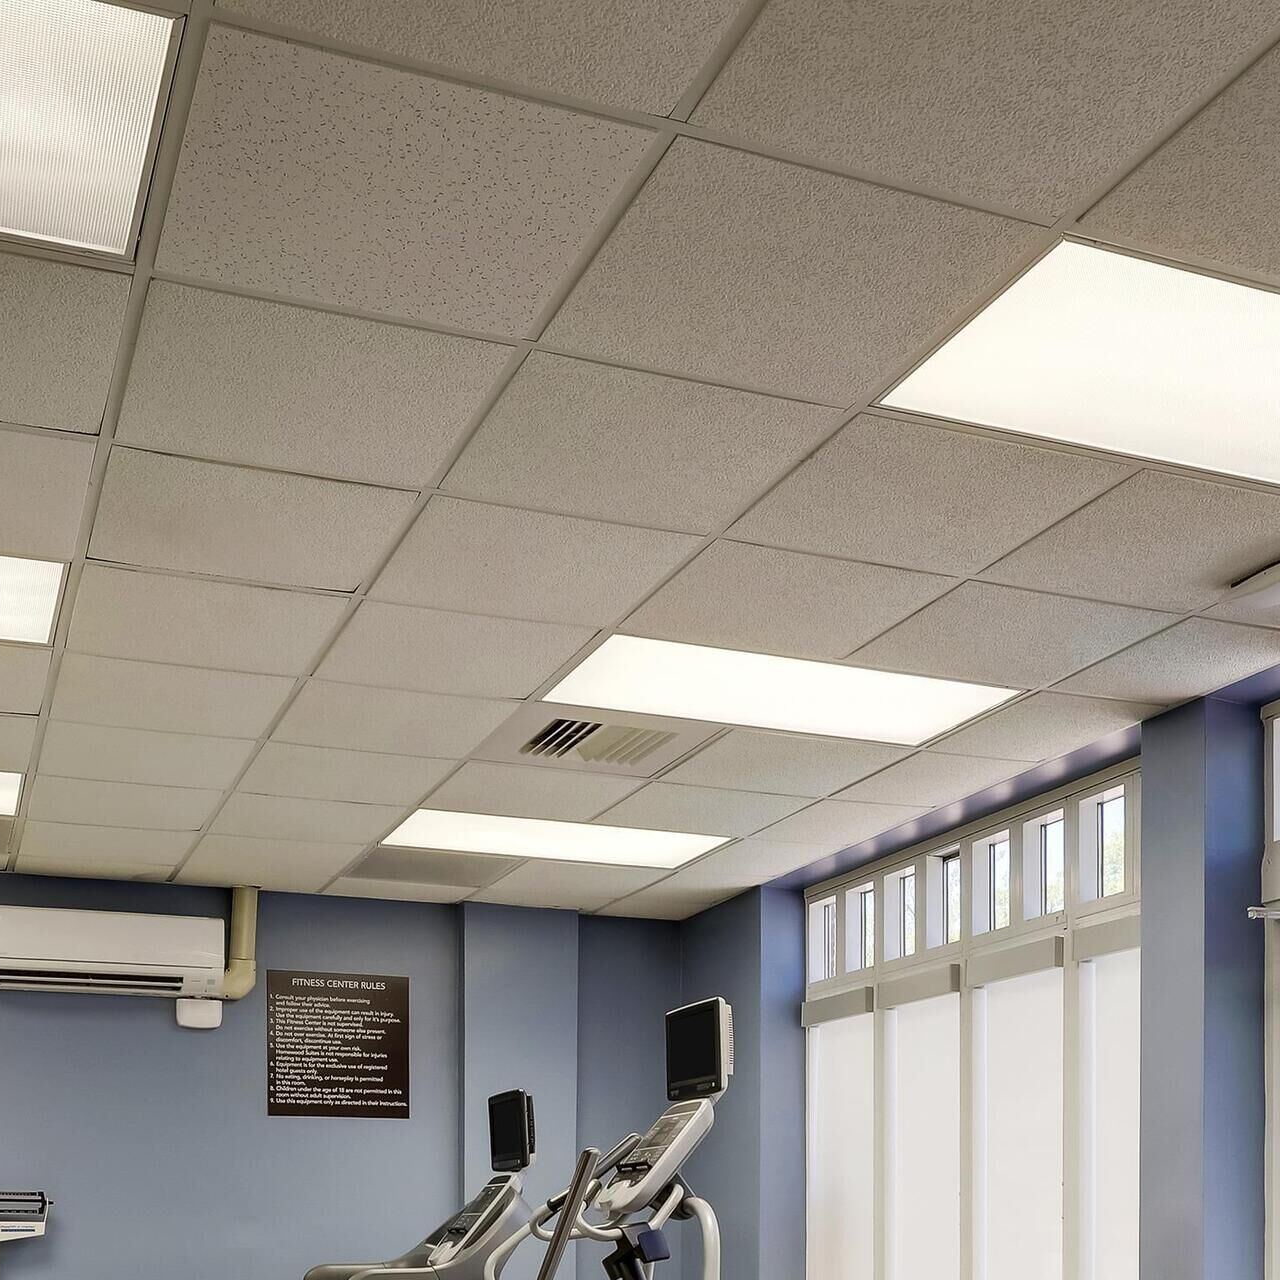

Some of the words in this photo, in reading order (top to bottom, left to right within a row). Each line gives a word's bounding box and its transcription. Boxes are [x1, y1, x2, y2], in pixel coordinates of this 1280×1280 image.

[292, 978, 324, 987] FITNESS
[326, 980, 359, 989] CENTER
[361, 981, 386, 990] RULES
